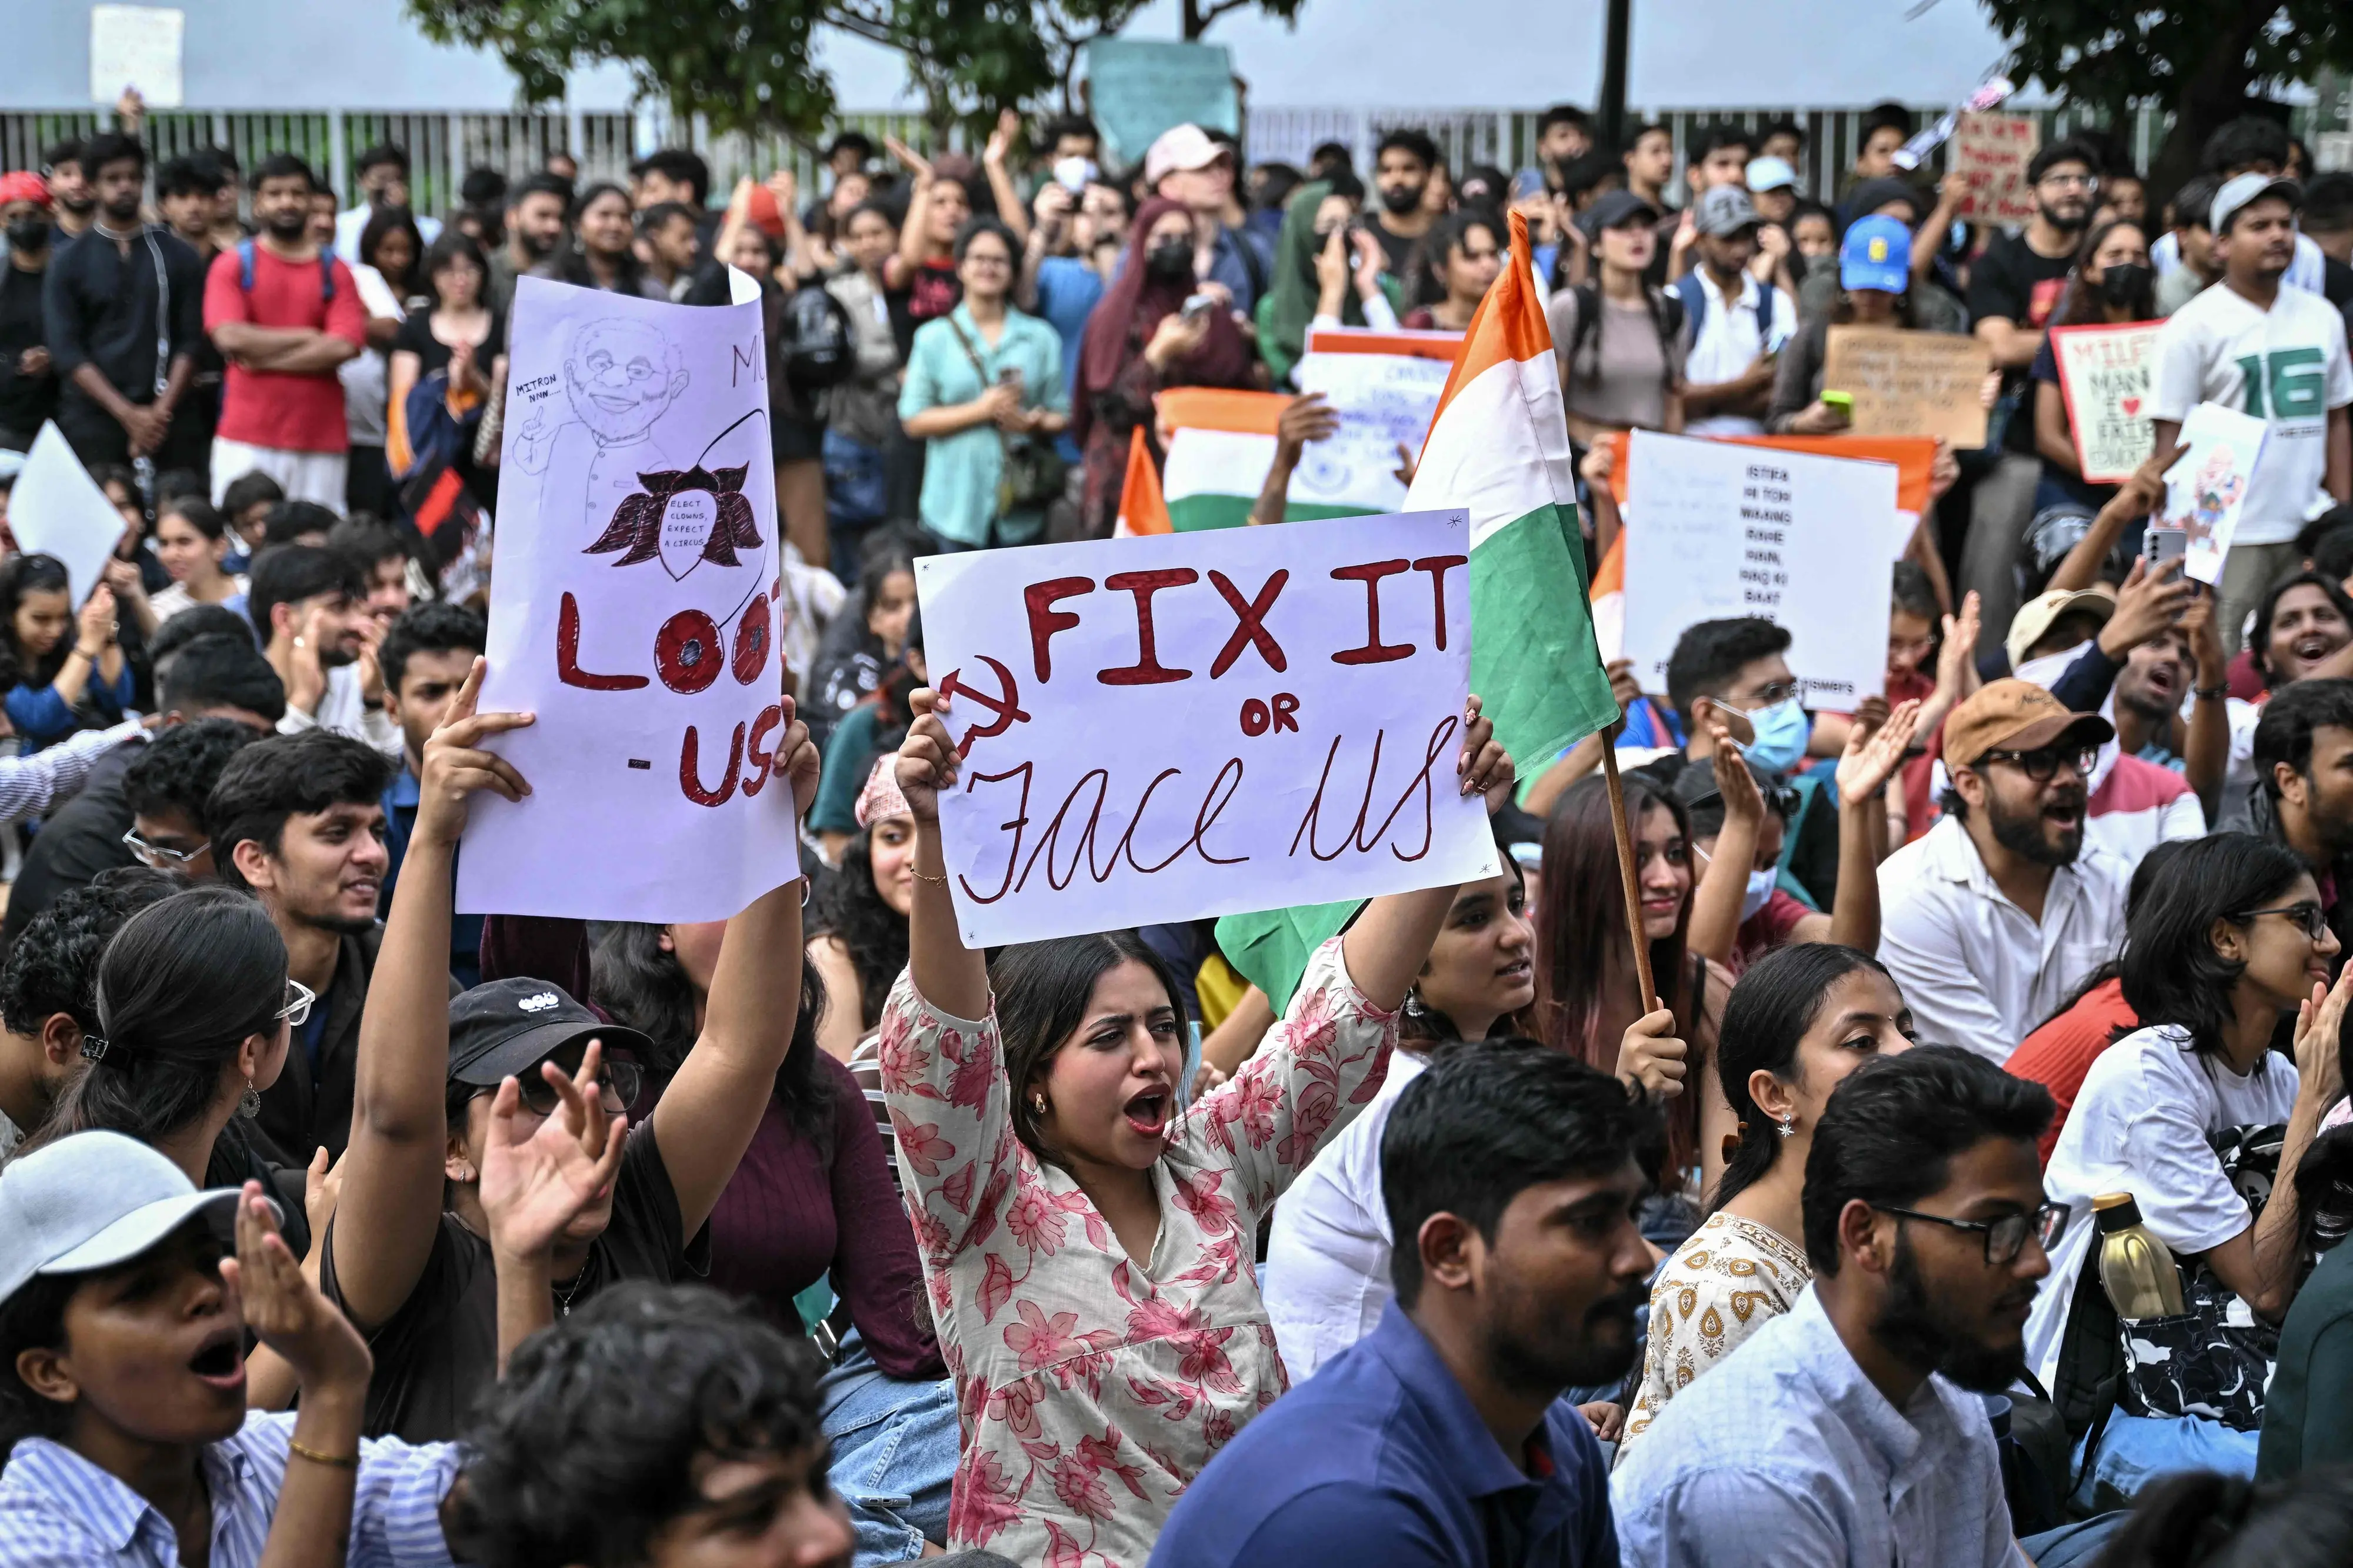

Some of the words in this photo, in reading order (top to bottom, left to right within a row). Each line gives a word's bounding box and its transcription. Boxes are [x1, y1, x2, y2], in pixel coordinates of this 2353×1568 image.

[516, 373, 556, 396] MITRON
[2235, 348, 2324, 420] 16
[668, 525, 704, 533] EXPECT
[674, 539, 704, 547] CIRCUS
[1024, 568, 1289, 685] FIX
[1330, 555, 1468, 665] IT
[1240, 693, 1299, 736] OR
[679, 705, 781, 807] US
